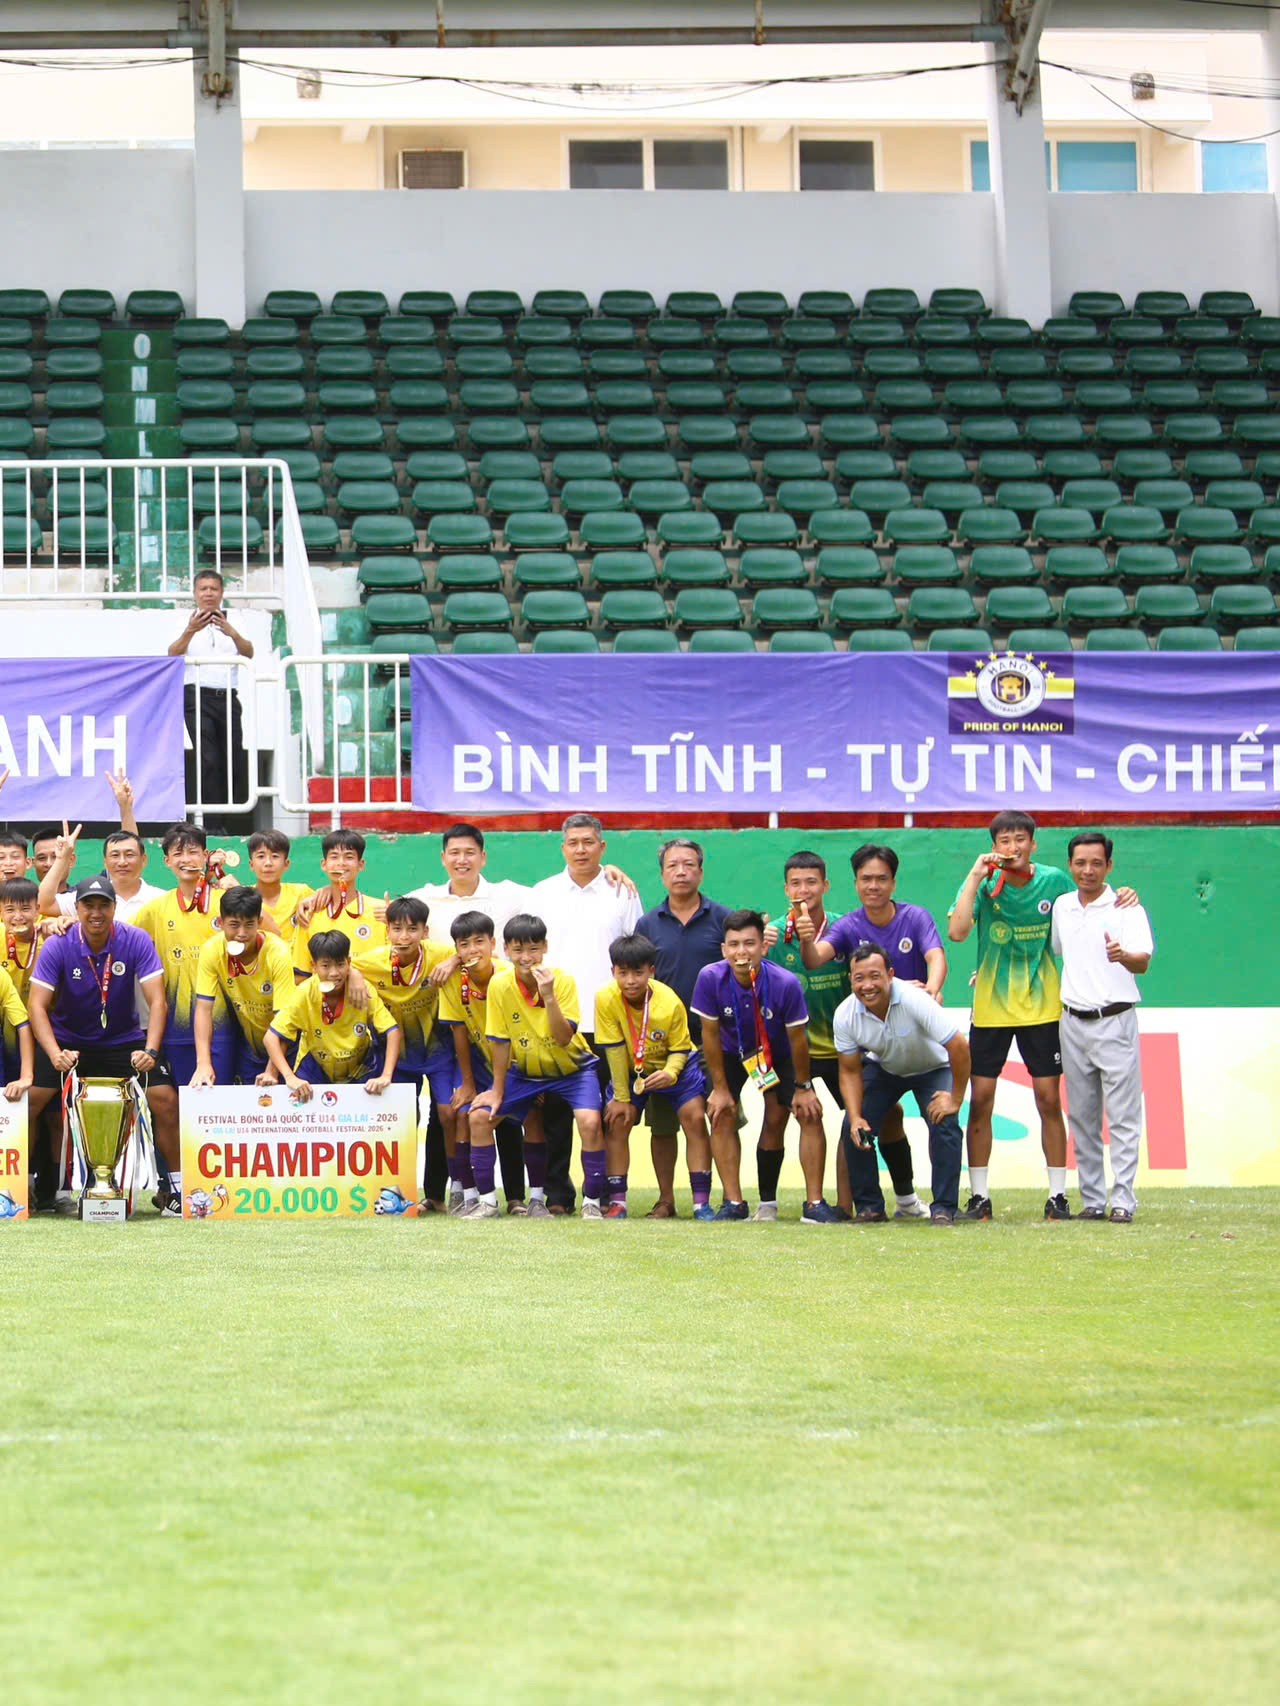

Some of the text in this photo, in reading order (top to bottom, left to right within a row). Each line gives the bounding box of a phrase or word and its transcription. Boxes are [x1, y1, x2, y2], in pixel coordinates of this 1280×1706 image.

[988, 661, 1034, 676] HANOI
[964, 722, 1064, 732] PRIDE OF HANOI
[453, 731, 607, 793] BÌNH
[631, 731, 782, 793] TĨNH
[846, 737, 935, 803] TỰ
[951, 744, 1052, 792] TIN
[1117, 724, 1280, 793] CHIẾ
[198, 1115, 237, 1125] FESTIVAL
[319, 1113, 336, 1123] U14
[376, 1113, 398, 1122] 2026
[251, 1126, 299, 1134] INTERNATIONAL
[336, 1125, 365, 1133] FESTIVAL
[198, 1140, 399, 1179] CHAMPION
[234, 1184, 368, 1215] 20.000 $
